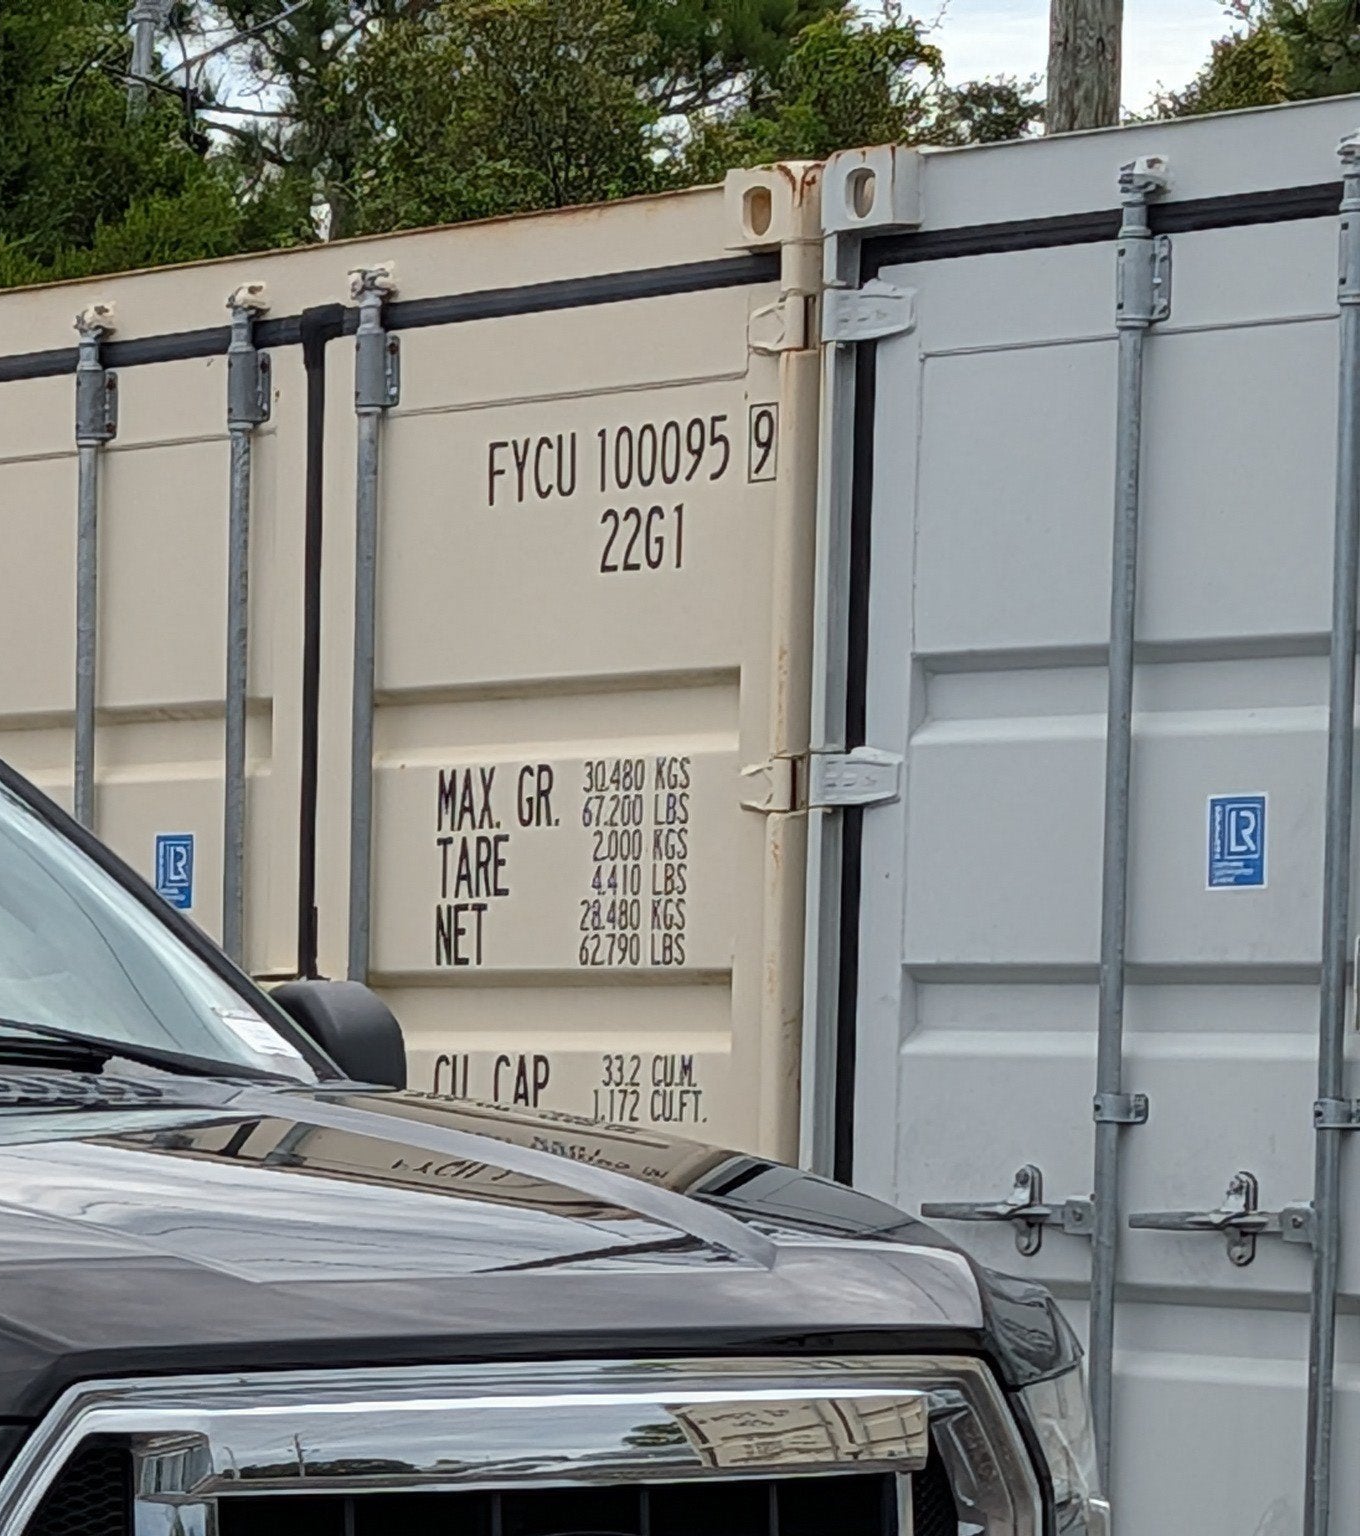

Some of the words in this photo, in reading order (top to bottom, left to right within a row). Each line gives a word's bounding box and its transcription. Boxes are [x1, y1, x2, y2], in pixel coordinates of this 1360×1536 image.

[488, 431, 577, 506] FYCU
[597, 414, 731, 493] 100095
[753, 409, 775, 475] 9
[600, 503, 684, 573] 22G1
[654, 757, 691, 791] KGS
[437, 765, 501, 832] MAX.
[517, 764, 560, 828] GR.
[653, 792, 690, 826] LBS
[652, 827, 689, 861] KGS
[436, 834, 510, 899] TARE
[651, 863, 688, 896] LBS
[435, 902, 488, 966] NET
[650, 898, 686, 931] KGS
[650, 932, 686, 966] LBS
[493, 1054, 550, 1108] CAP
